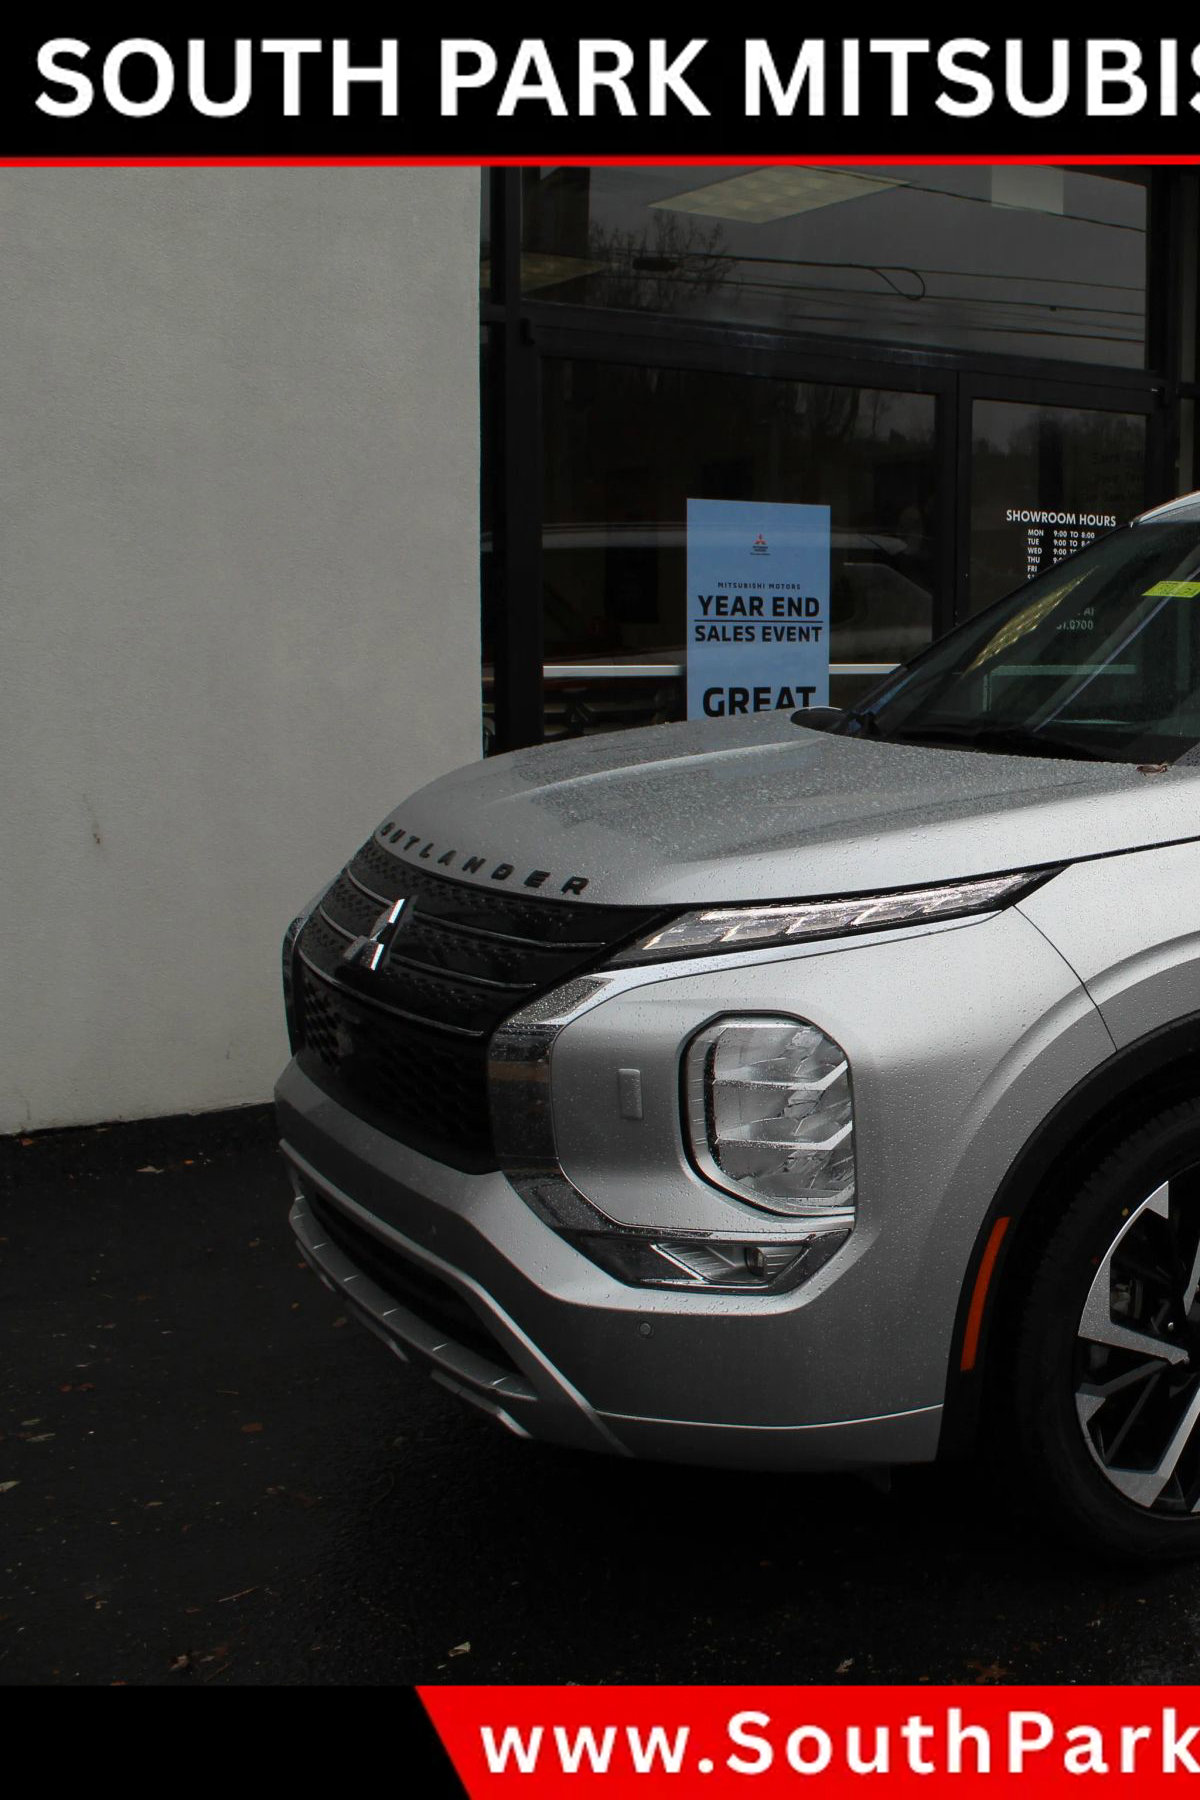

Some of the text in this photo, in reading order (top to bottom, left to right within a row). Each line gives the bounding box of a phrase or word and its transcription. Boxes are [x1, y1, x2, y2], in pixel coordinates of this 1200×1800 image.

[1006, 509, 1117, 527] SHOWROOM HOURS
[1027, 529, 1044, 537] MON
[1053, 530, 1067, 538] 9:00
[1053, 539, 1067, 547] 9:00
[1027, 547, 1042, 555] WED
[1027, 565, 1038, 573] FRI
[718, 582, 766, 590] MITSUBISHI
[698, 595, 820, 617] YEAR END
[695, 625, 823, 643] SALES EVENT
[703, 686, 816, 718] GREAT
[380, 822, 590, 896] OUTLANDER
